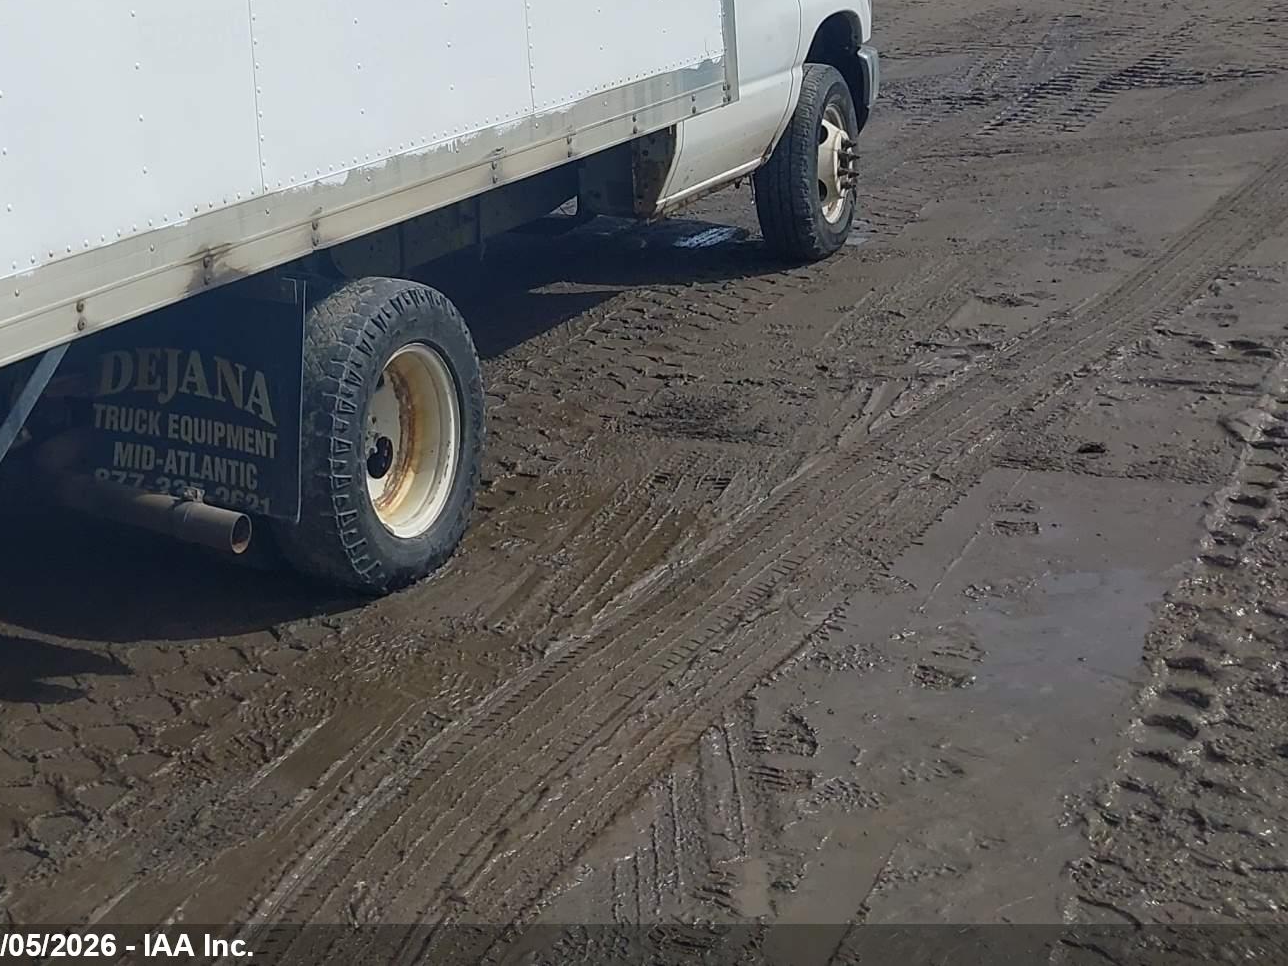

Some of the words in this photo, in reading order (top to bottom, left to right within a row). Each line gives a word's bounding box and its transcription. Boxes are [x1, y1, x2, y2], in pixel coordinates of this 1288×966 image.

[96, 346, 277, 427] DEJANA
[93, 402, 161, 437] TRUCK
[167, 412, 279, 459] EQUIPMENT
[113, 441, 259, 491] MID-ATLANTIC
